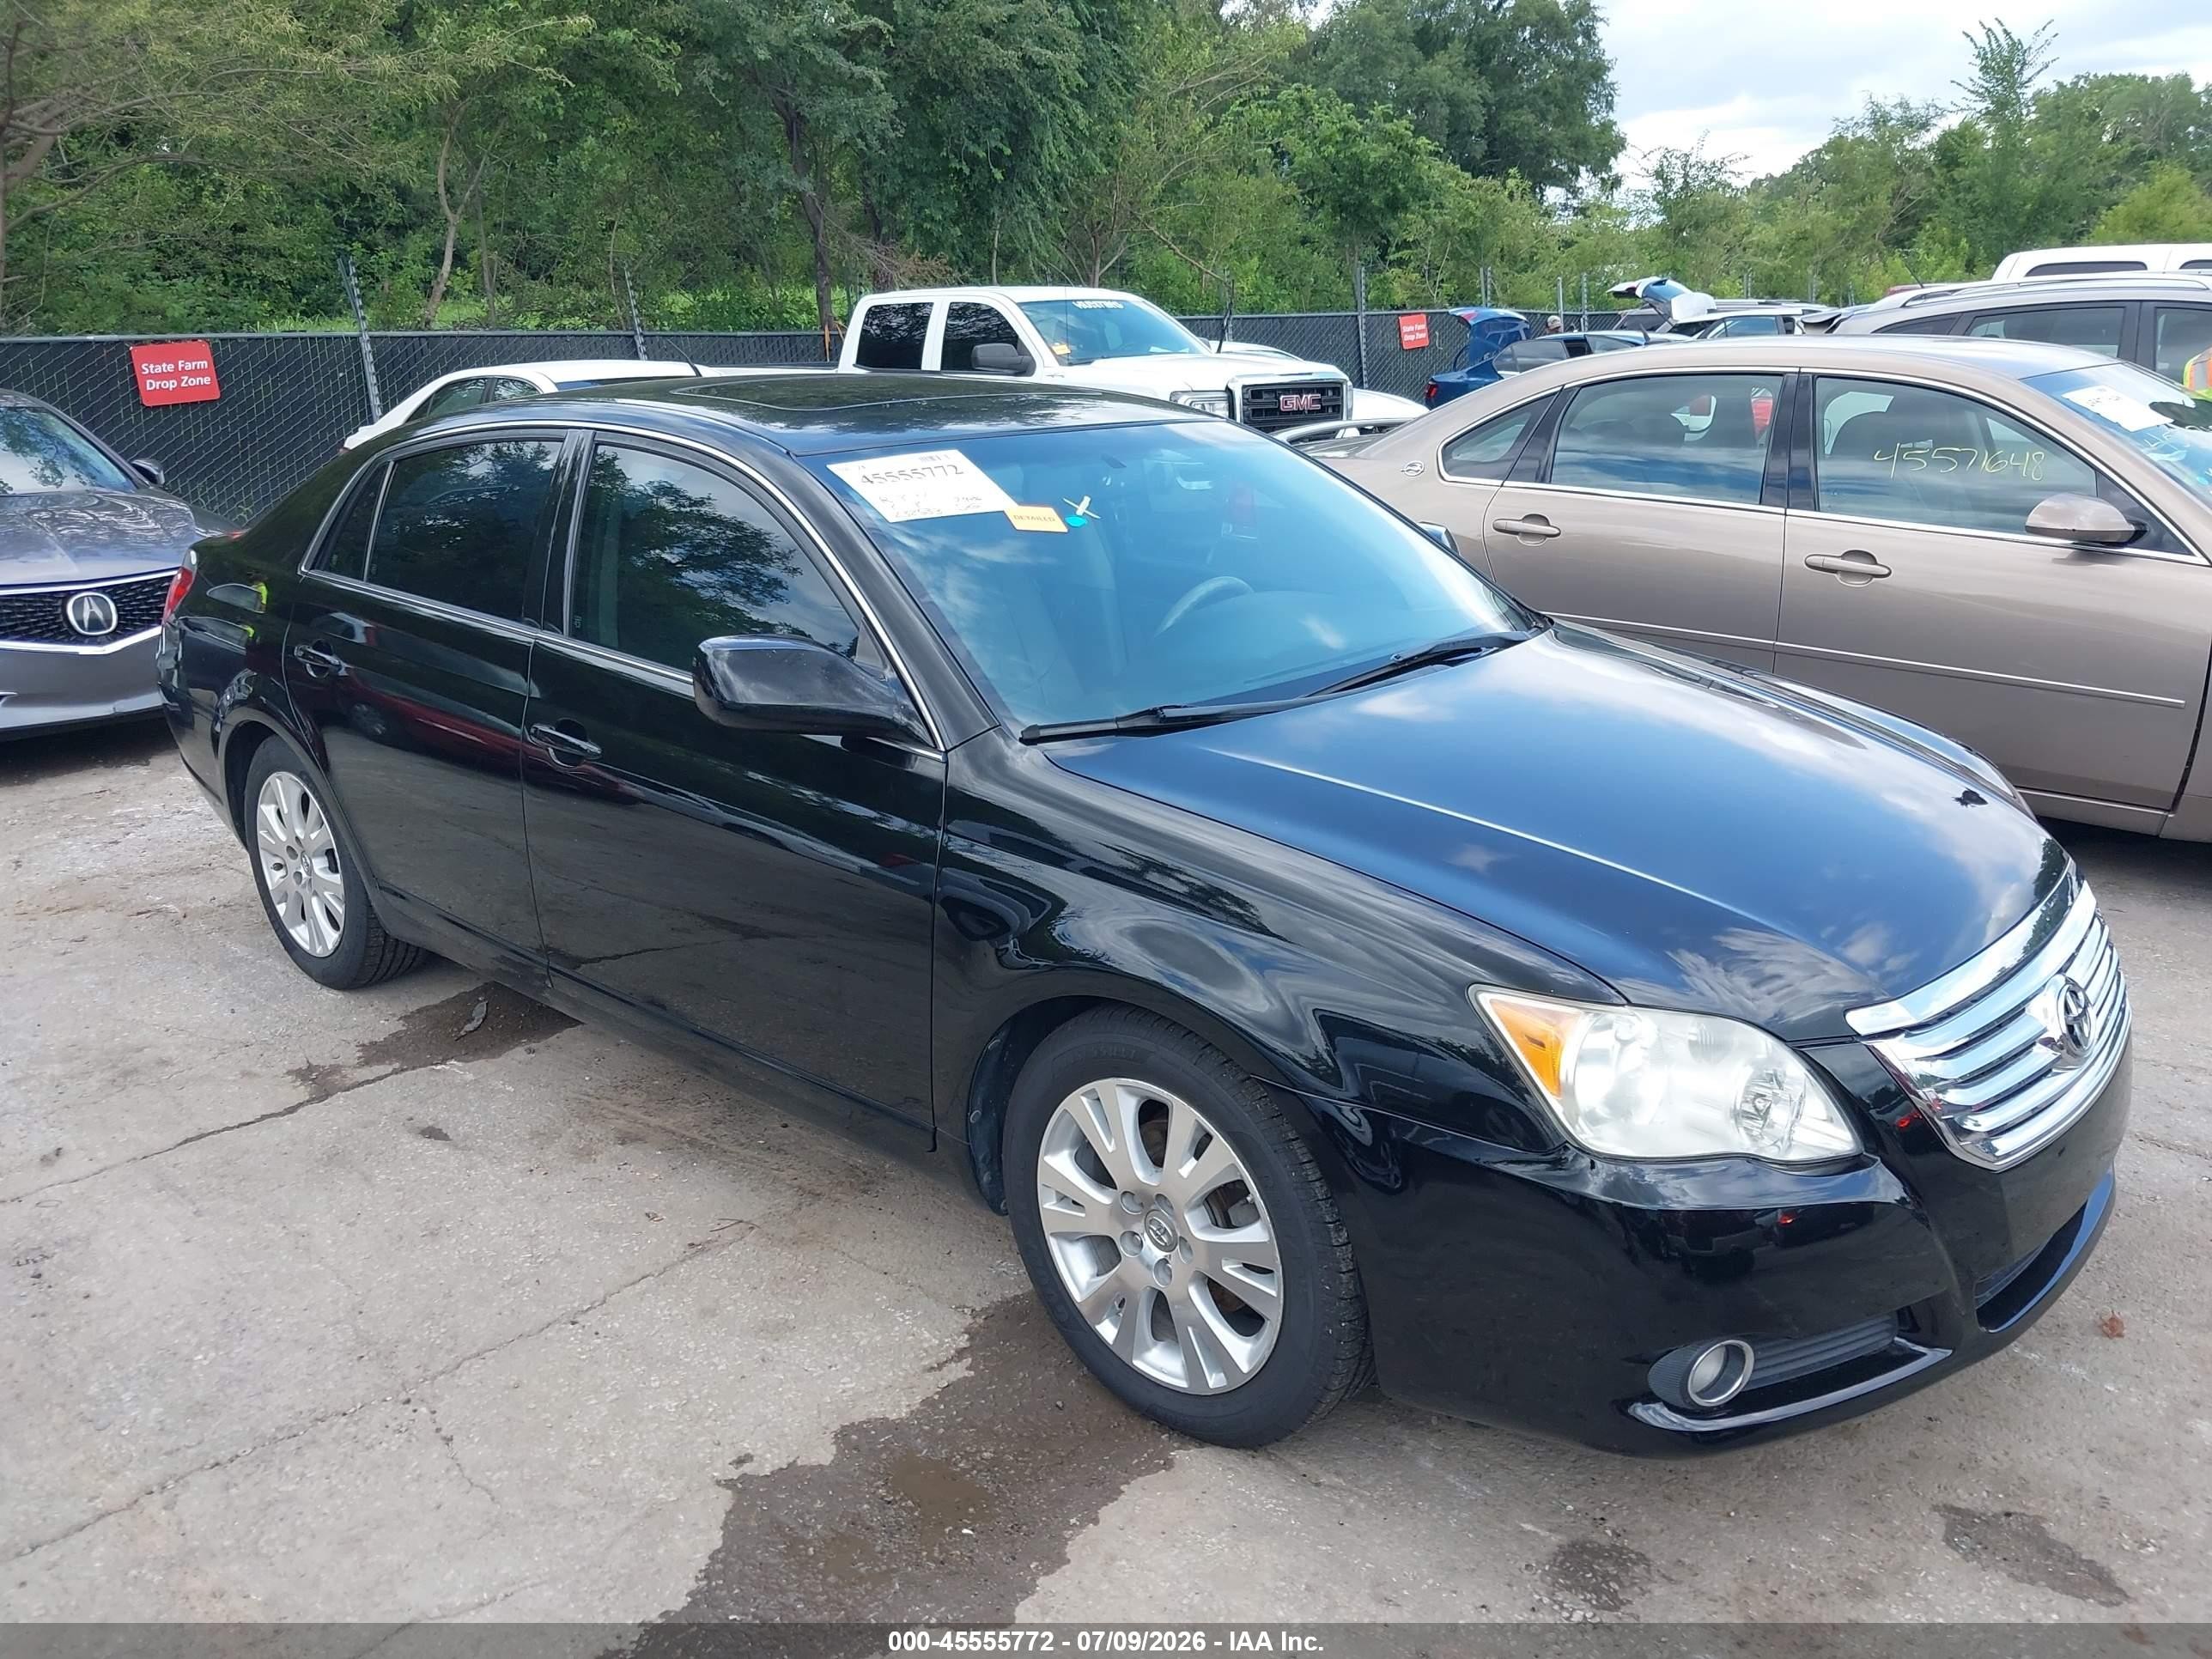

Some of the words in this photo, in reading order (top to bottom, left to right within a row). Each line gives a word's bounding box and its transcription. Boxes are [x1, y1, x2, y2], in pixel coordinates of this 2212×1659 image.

[141, 362, 174, 374] State
[178, 360, 208, 371] Farm
[146, 379, 177, 391] Drop
[180, 376, 211, 387] Zone
[1279, 393, 1322, 411] GMC
[1874, 442, 2045, 481] 45571648
[861, 464, 964, 486] 45555772
